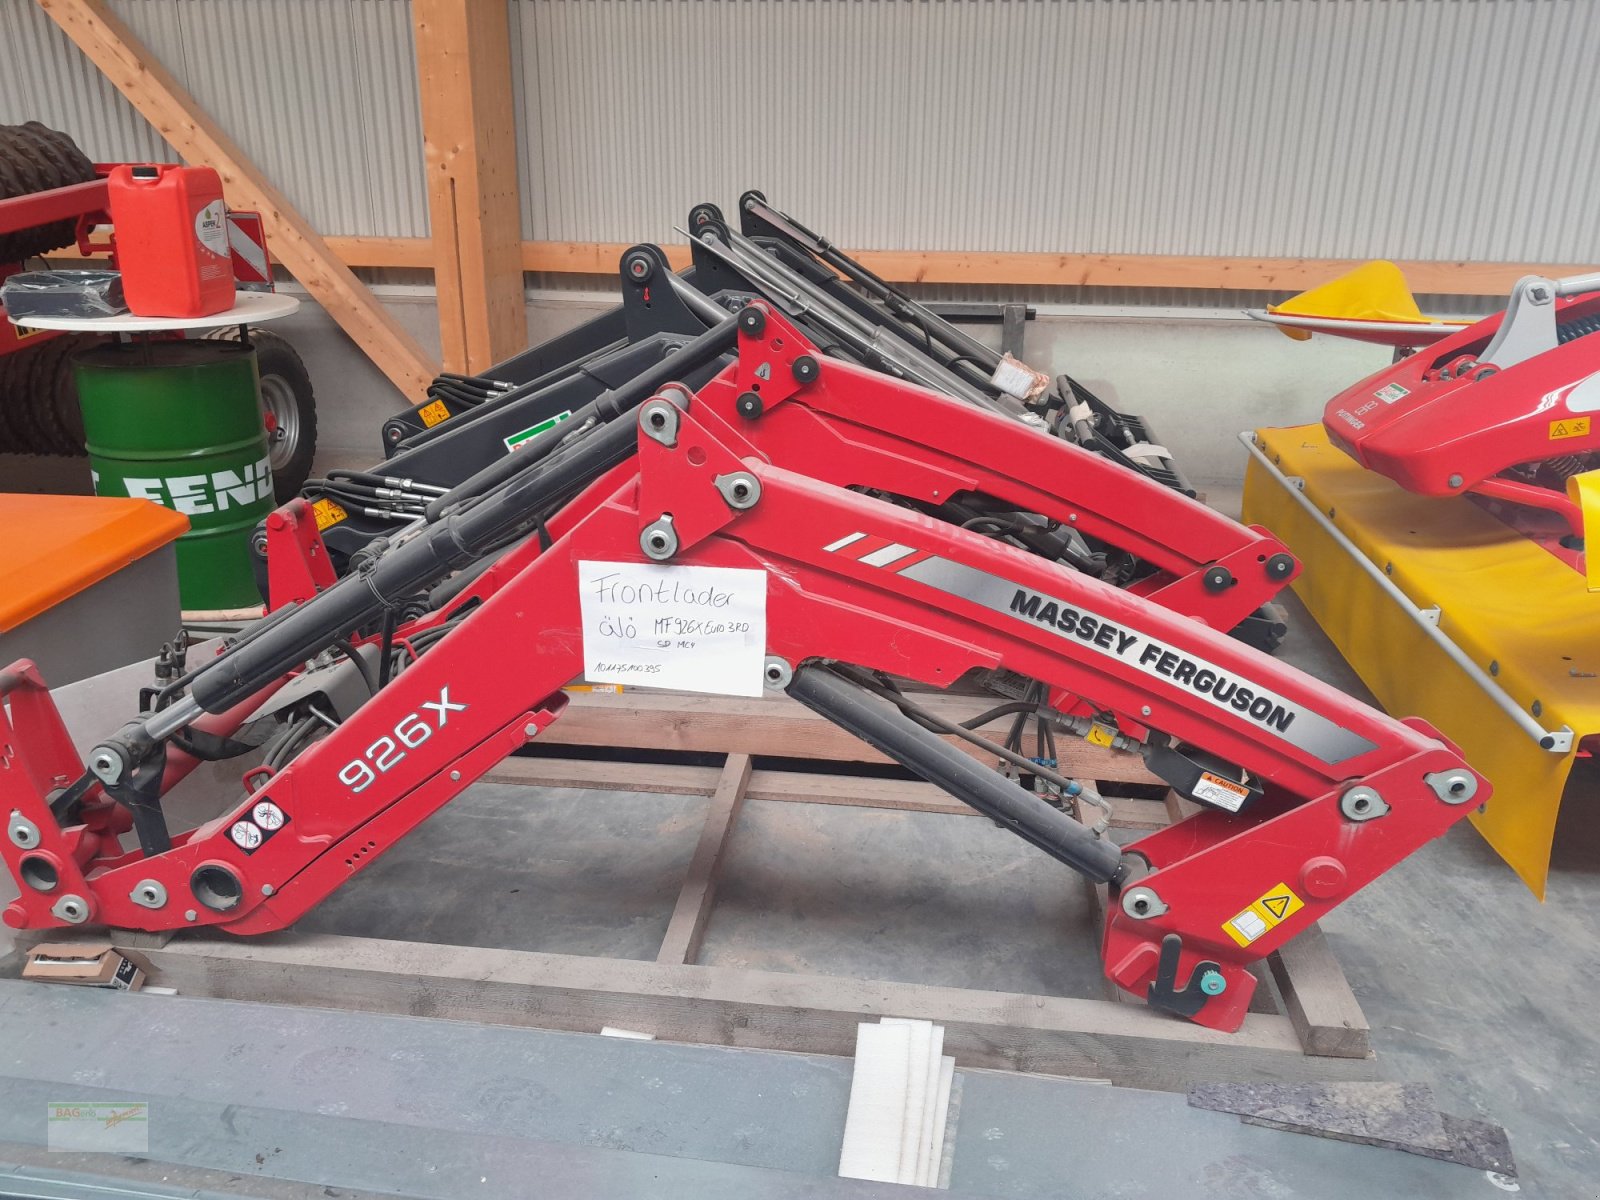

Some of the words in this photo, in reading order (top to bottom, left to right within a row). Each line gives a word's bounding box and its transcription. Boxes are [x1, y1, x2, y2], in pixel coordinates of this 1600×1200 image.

[591, 572, 735, 608] Frontlader
[655, 617, 673, 635] MF
[1009, 589, 1137, 655] MASSEY
[1139, 643, 1296, 733] FERGUSON
[338, 686, 470, 793] 926X
[1214, 778, 1244, 794] CAUTION
